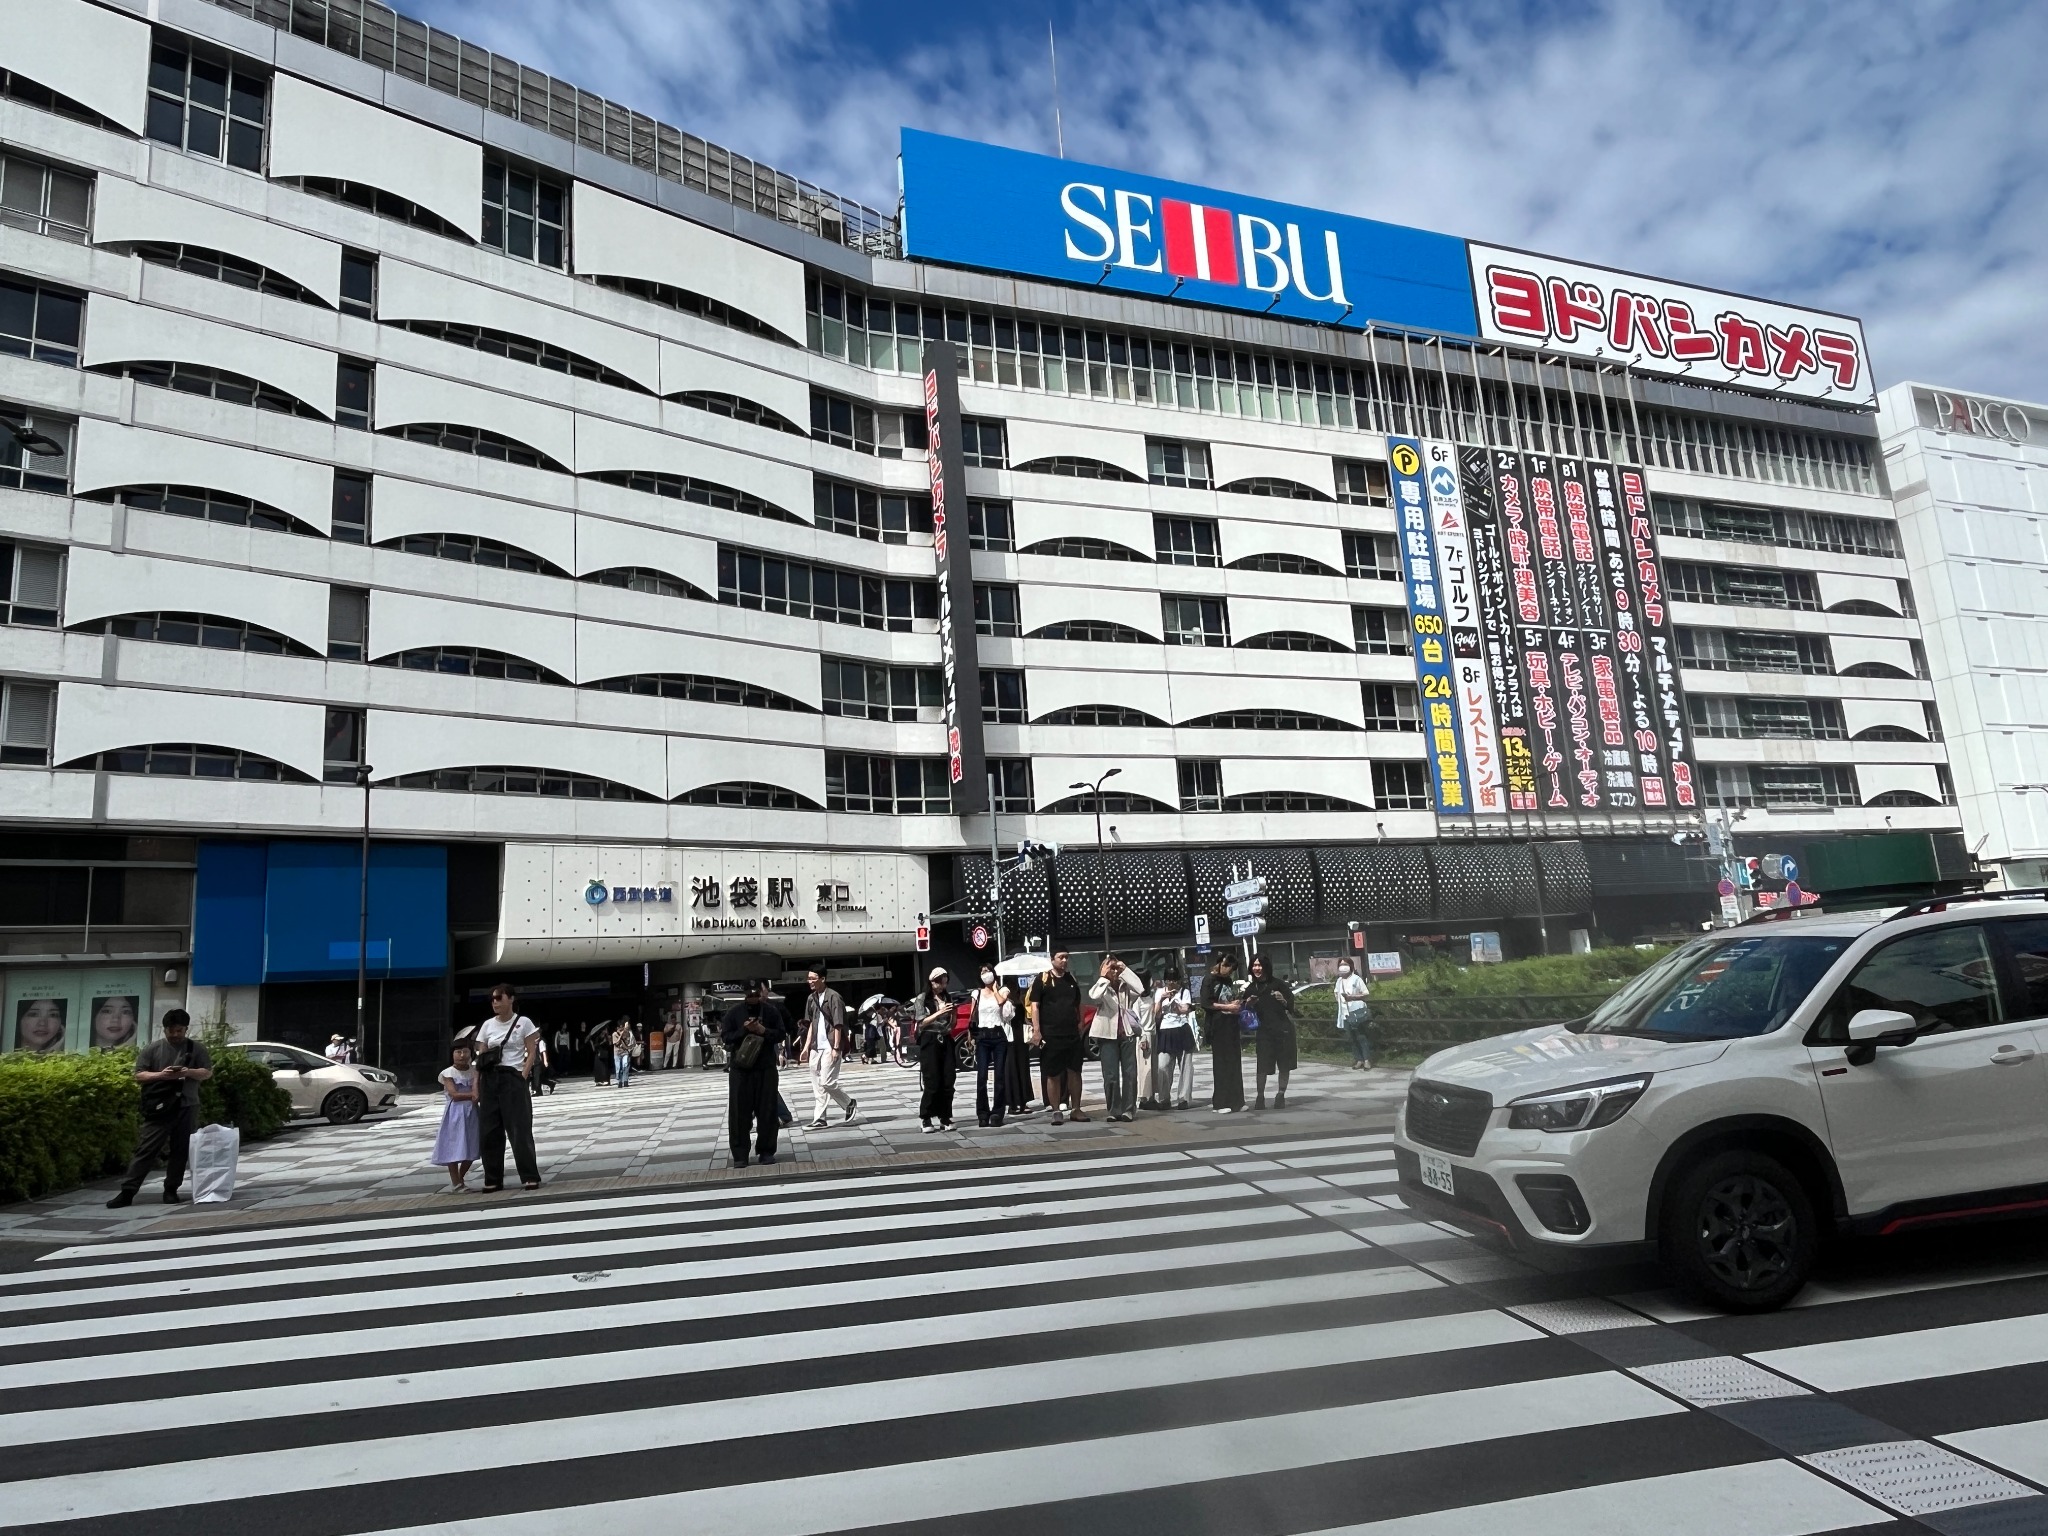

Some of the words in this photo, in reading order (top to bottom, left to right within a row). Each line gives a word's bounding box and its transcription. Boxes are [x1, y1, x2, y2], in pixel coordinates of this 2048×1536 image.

[1060, 182, 1354, 306] SEIBU
[1487, 264, 1861, 390] ヨドバシカメラ
[1933, 393, 2030, 442] PARCO
[1431, 446, 1448, 462] 6F
[1497, 453, 1515, 469] 2F
[1531, 457, 1546, 473] 1F
[1562, 461, 1576, 477] B1
[1532, 477, 1562, 559] 携帯電話
[1564, 481, 1594, 562] 携帯電話
[1594, 469, 1620, 548] 営業時間
[1399, 480, 1437, 609] 専用駐車場
[1445, 545, 1463, 562] 7F
[925, 368, 947, 562] ヨドバシカメラ
[938, 570, 956, 727] マルチメディア
[949, 726, 962, 784] 池袋
[1449, 566, 1469, 622] ゴルフ
[1544, 560, 1561, 625] インターネット
[1556, 561, 1574, 624] スマートフォン
[1587, 564, 1602, 627] アクセサリー
[1454, 633, 1477, 648] Golf
[1524, 629, 1542, 647] 5F
[1558, 631, 1574, 648] 4F
[1589, 633, 1607, 649] 3F
[1623, 472, 1663, 626] ヨドバシカメラ
[1651, 637, 1683, 760] マルチメディア
[1672, 761, 1697, 806] 池袋
[1462, 666, 1480, 683] 8F
[1592, 654, 1623, 745] 家電製品
[1467, 687, 1496, 807] レストラン街
[1610, 793, 1636, 807] エアコン
[691, 876, 795, 909] 池袋駅
[816, 882, 849, 902] 東口
[692, 916, 757, 929] Ikebukuro
[762, 916, 806, 929] Station
[1197, 917, 1205, 932] P
